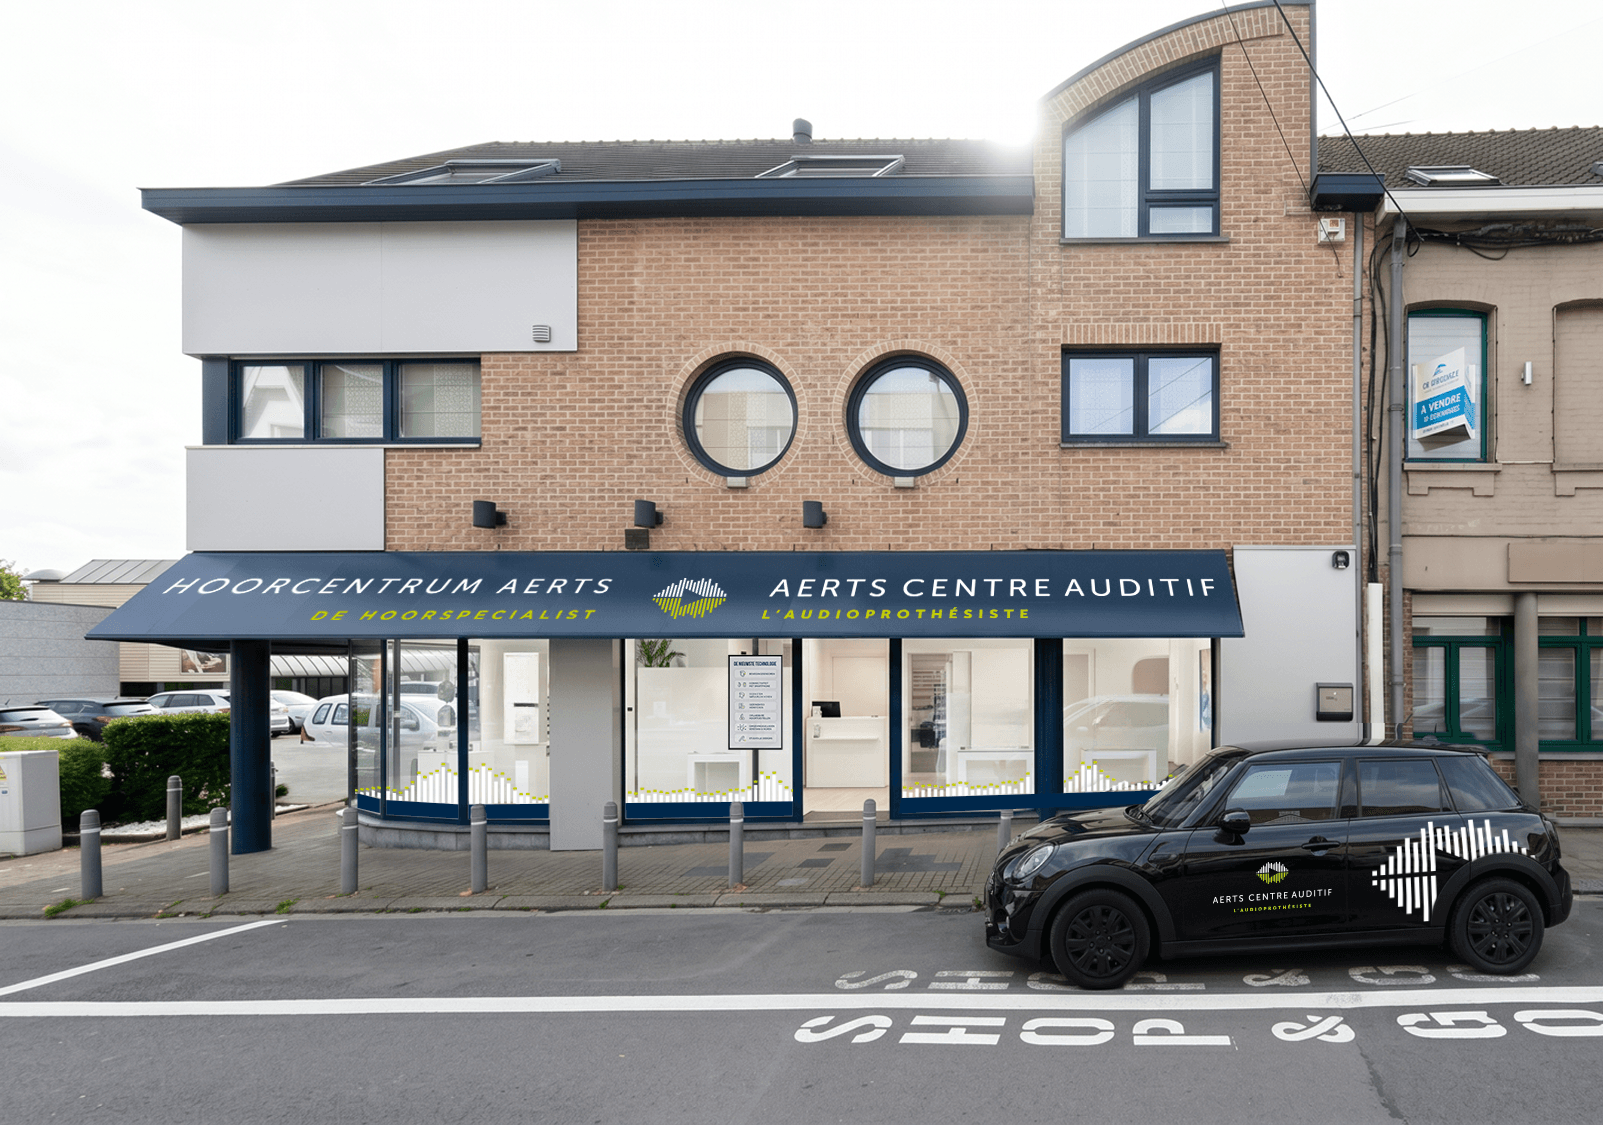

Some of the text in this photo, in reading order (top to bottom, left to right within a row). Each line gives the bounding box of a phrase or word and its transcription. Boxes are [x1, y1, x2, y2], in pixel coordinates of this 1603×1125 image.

[1420, 405, 1427, 415] A
[1428, 393, 1461, 412] VENDRE
[163, 578, 613, 594] HOORCENTRUM AERTS
[769, 578, 1215, 597] AERTS CENTRE AUDITIF
[310, 609, 597, 621] DE HOORSPECIALIST
[761, 607, 1029, 620] L'AUDIOPROTHÉSISTE
[1212, 888, 1333, 904] AERTS CENTRE AUDITIF
[794, 1009, 1603, 1046] SHOP & GO
